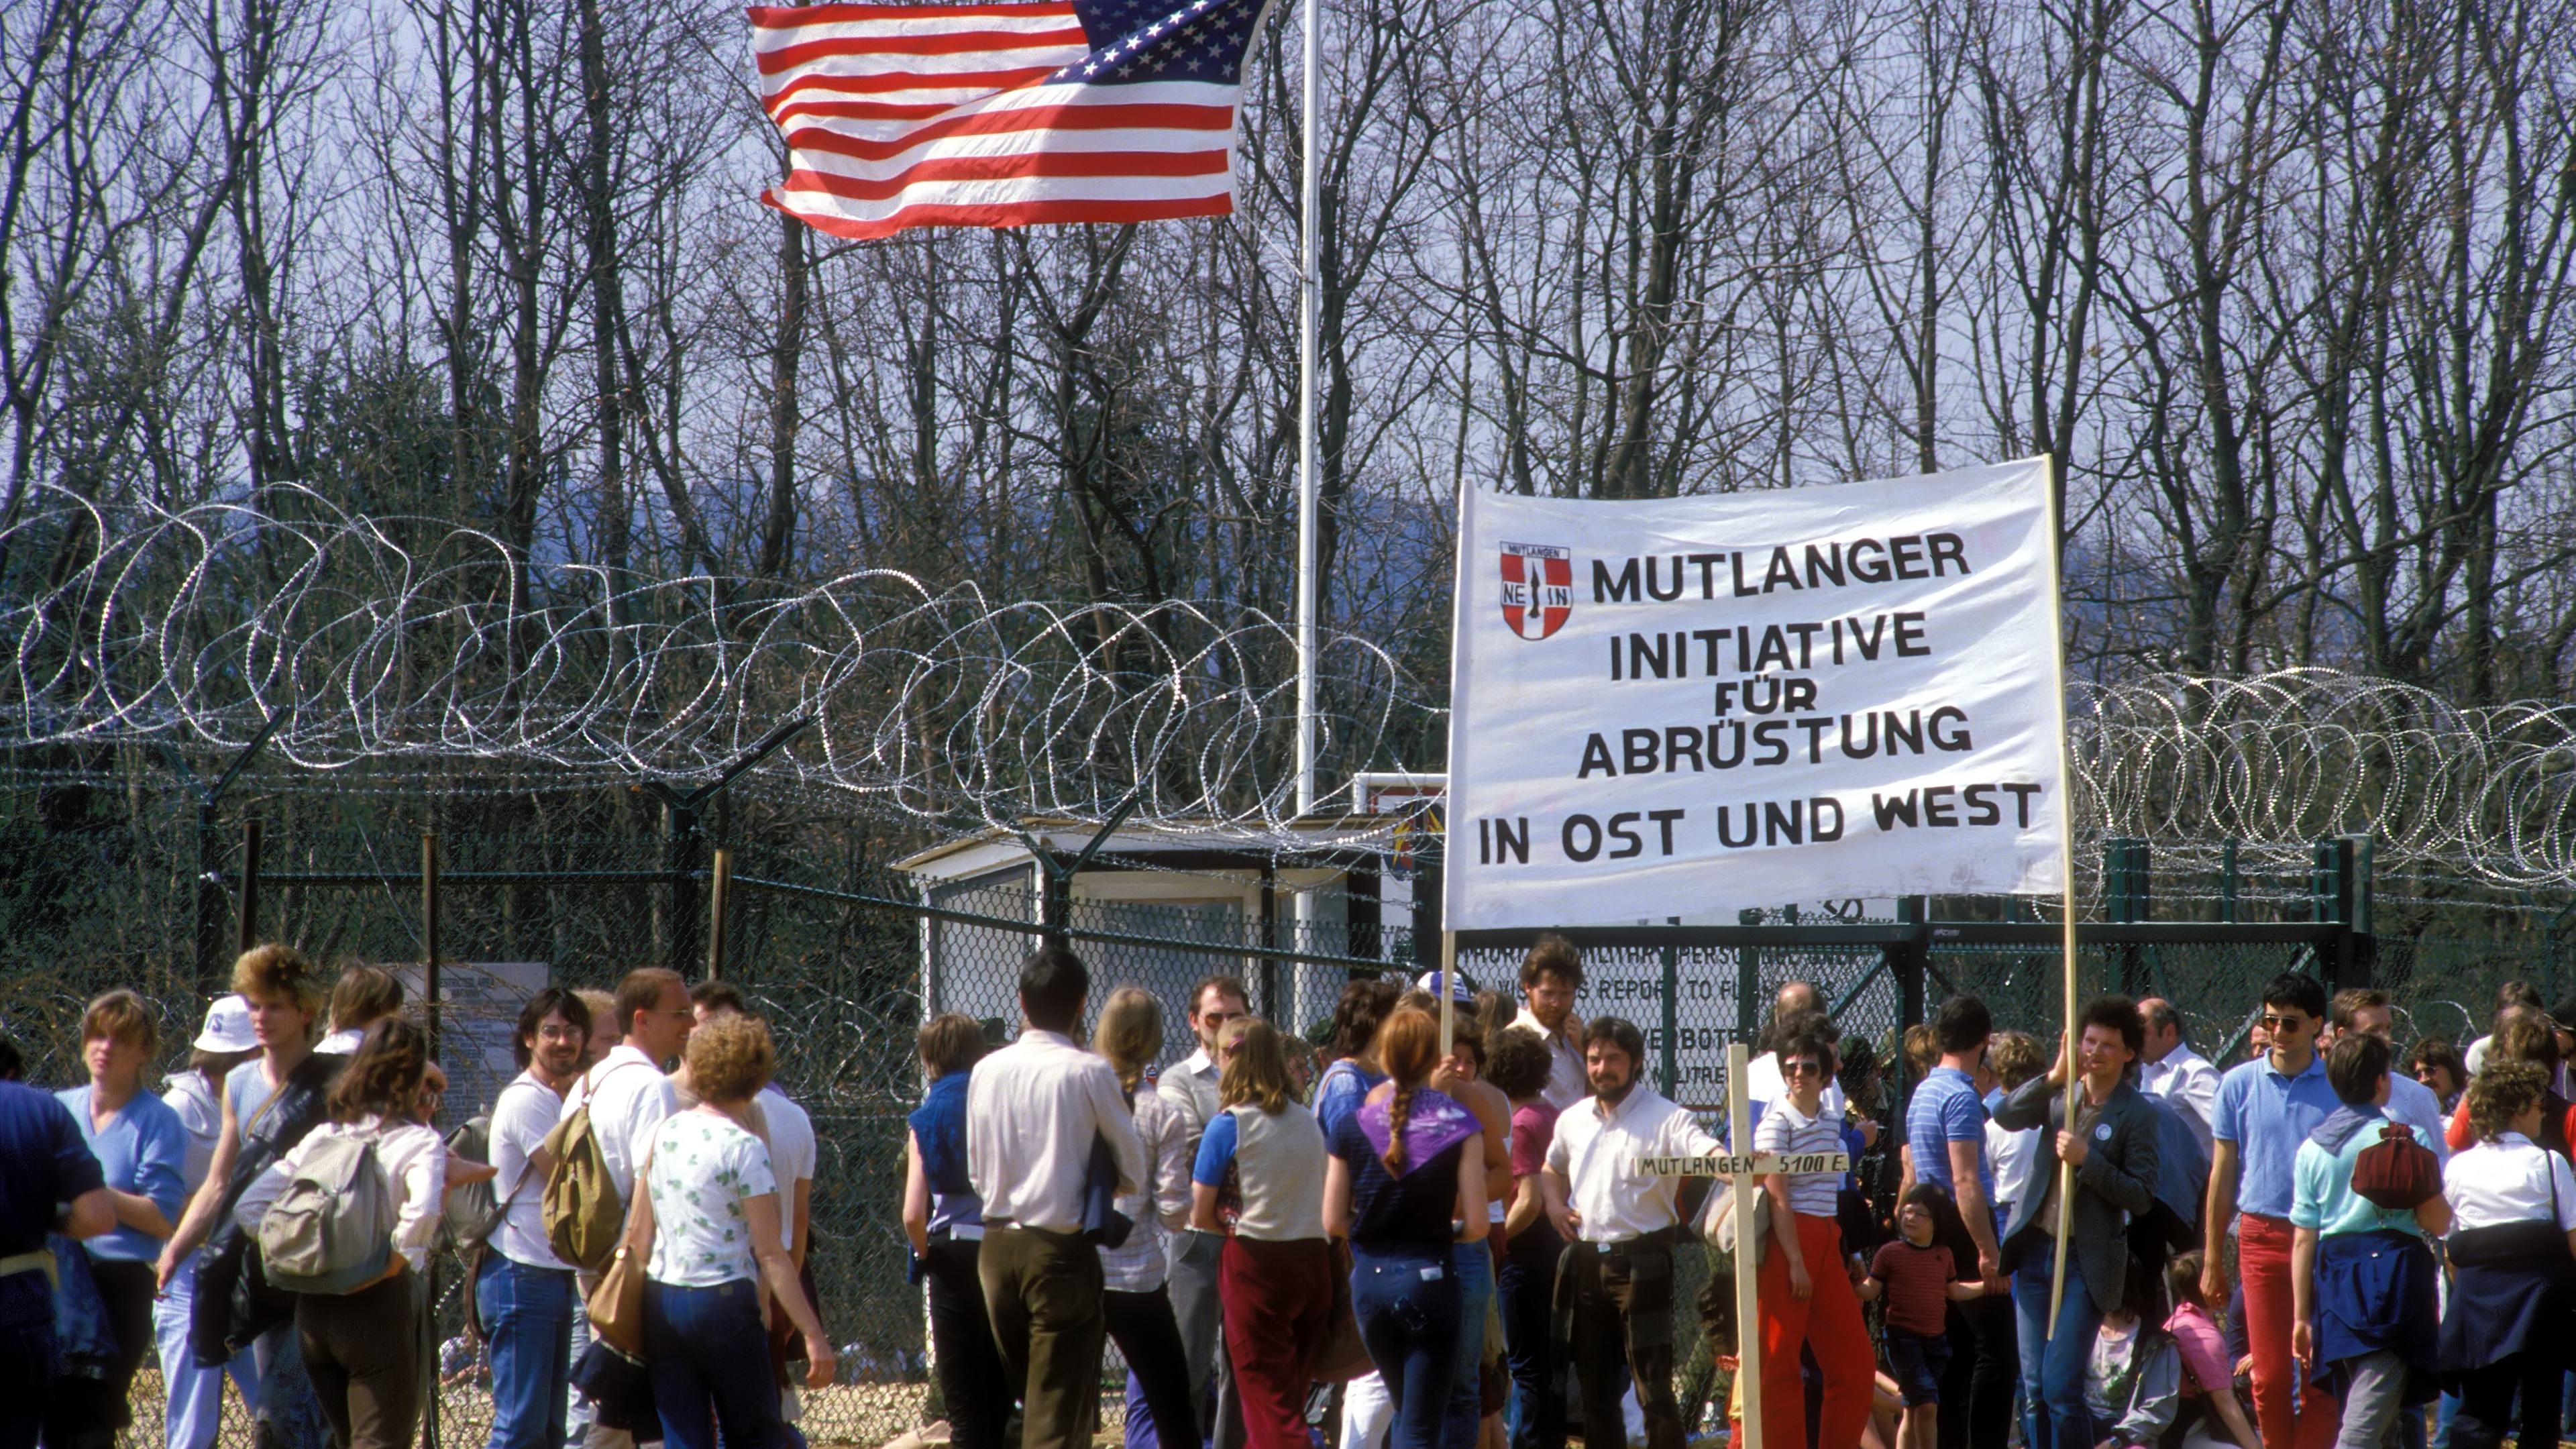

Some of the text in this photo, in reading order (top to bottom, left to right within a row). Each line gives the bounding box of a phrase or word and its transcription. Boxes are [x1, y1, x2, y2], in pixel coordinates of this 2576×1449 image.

[1509, 544, 1560, 557] MUTLANGEN
[1593, 533, 1971, 603] MUTLANGER
[1611, 612, 1931, 680] INITIATIVE
[1715, 675, 1817, 716] FÜR
[1577, 706, 1972, 778] ABRÜSTUNG
[1479, 783, 2041, 865] IN OST UND WEST
[1599, 980, 1664, 1000] REPOR
[1686, 980, 1711, 1000] TO
[1641, 1155, 1756, 1175] MUTLANGEN
[1779, 1154, 1824, 1173] 5100
